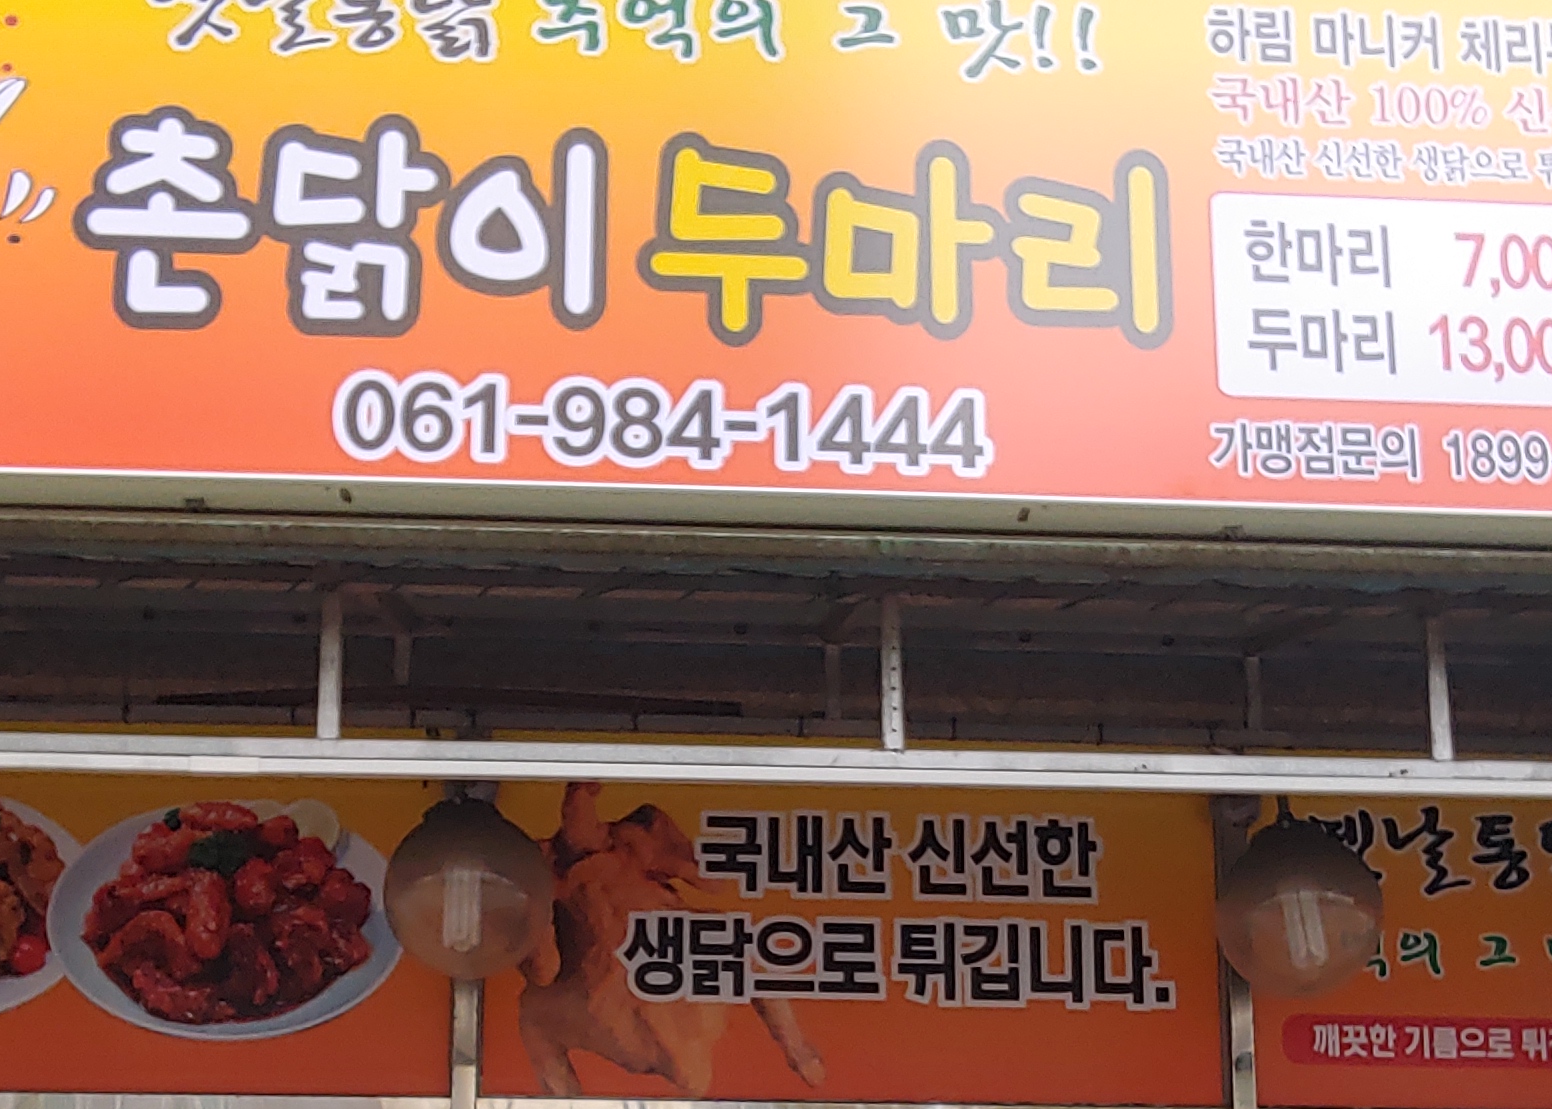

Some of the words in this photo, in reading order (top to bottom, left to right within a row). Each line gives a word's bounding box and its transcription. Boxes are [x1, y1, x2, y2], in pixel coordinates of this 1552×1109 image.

[839, 5, 895, 48] 그
[1207, 9, 1292, 64] 하림
[1313, 13, 1440, 69] 마니커
[1213, 77, 1351, 125] 국내산
[1371, 85, 1491, 127] 100%
[1217, 139, 1306, 177] 국내산
[1315, 143, 1402, 180] 신선한
[1412, 146, 1529, 184] 생닭으로
[75, 106, 606, 334] 촌닭이
[637, 127, 1171, 349] 두마리
[1244, 220, 1391, 287] 한마리
[1248, 307, 1398, 375] 두마리
[341, 377, 986, 470] 061-984-1444
[1211, 423, 1420, 480] 가맹점문의
[698, 813, 892, 897] 국내산
[908, 816, 1100, 901] 신선한
[622, 915, 884, 999] 생닭으로
[898, 919, 1174, 1007] 튀깁니다.
[1479, 934, 1518, 966] 그
[1312, 1023, 1397, 1058] 깨끗한
[1405, 1025, 1515, 1060] 기름으로
